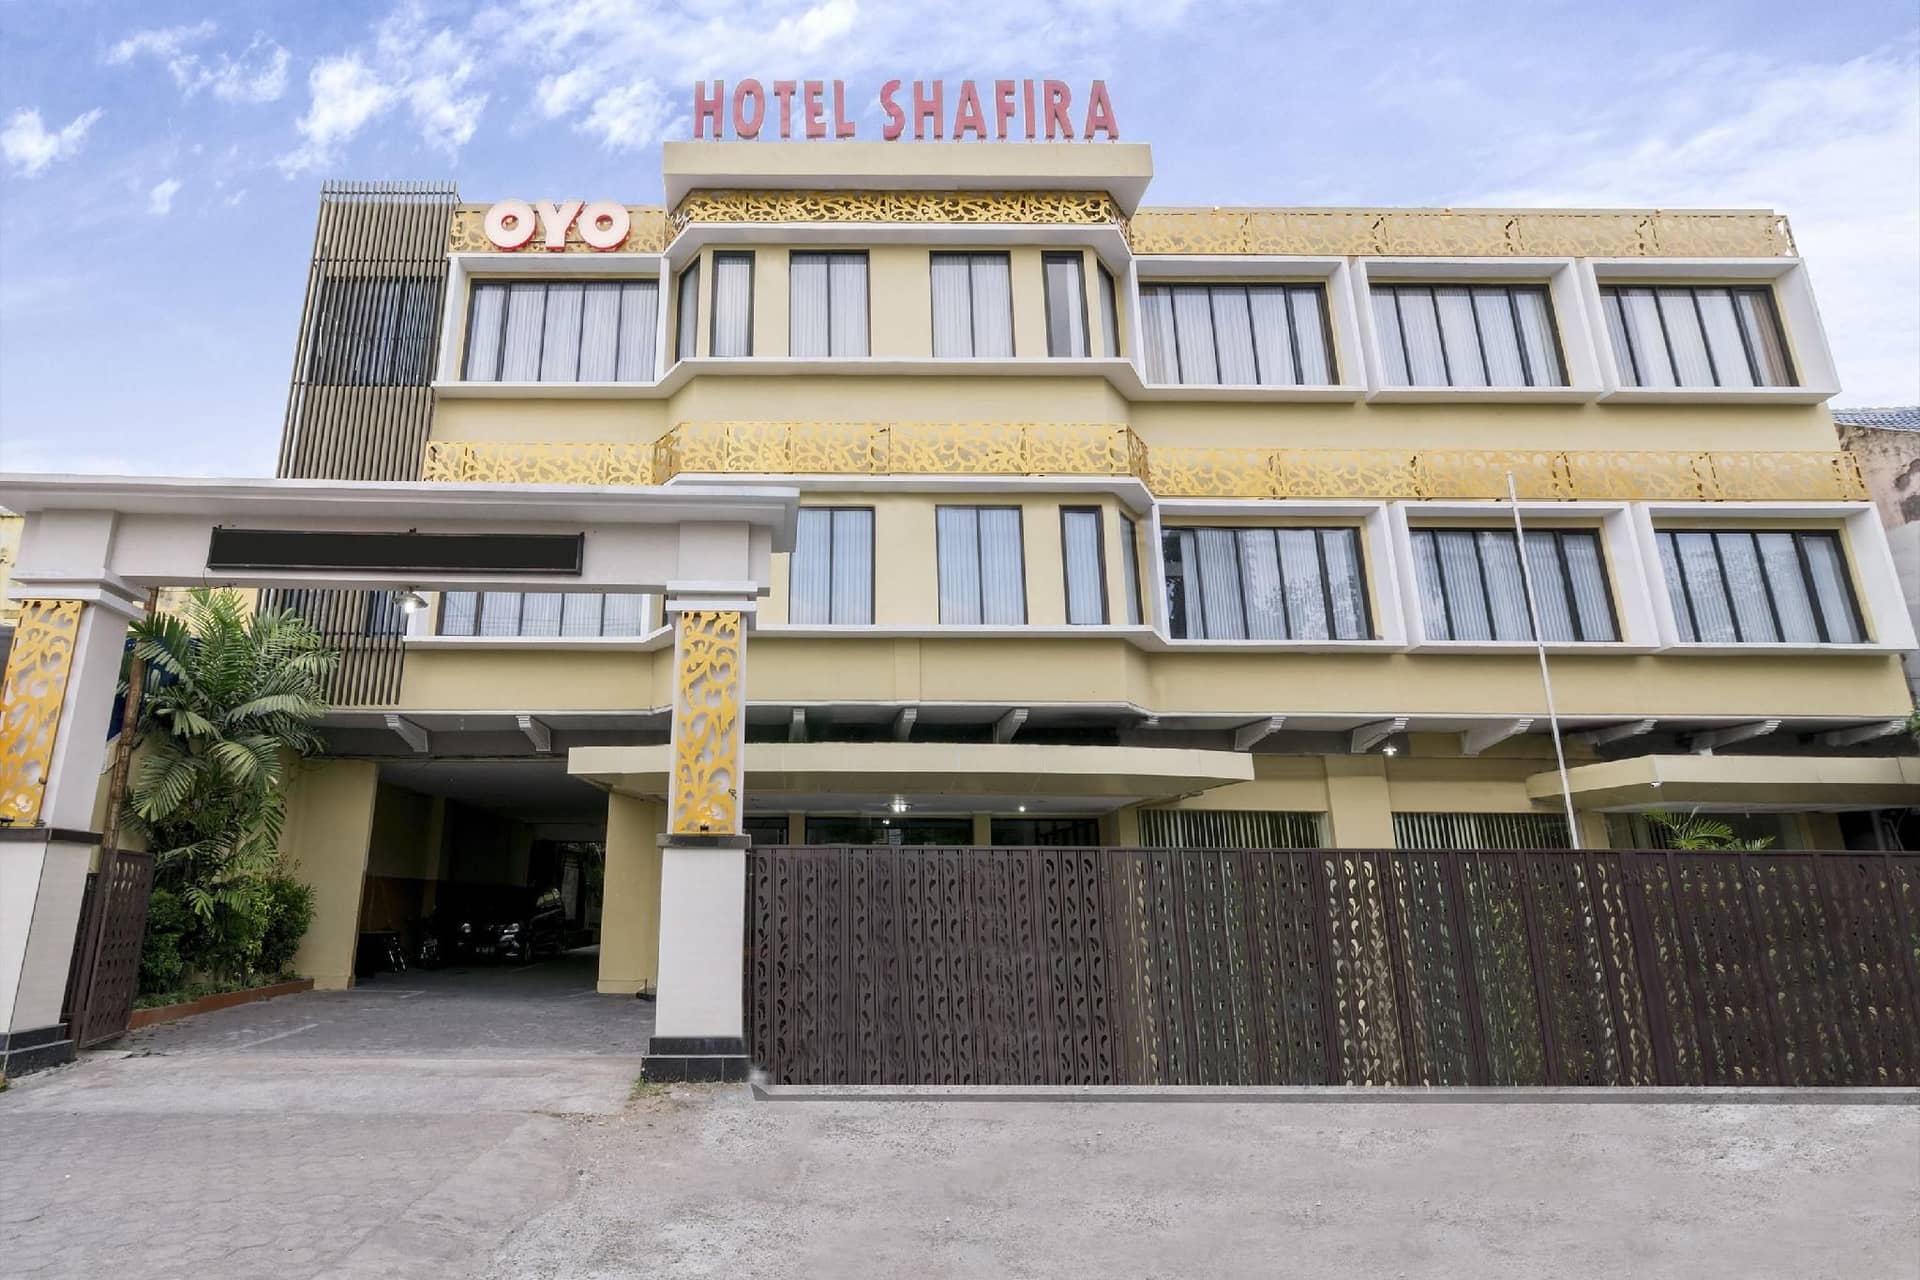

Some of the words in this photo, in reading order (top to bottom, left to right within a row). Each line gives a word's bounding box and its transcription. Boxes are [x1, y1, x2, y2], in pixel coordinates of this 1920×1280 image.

[694, 79, 856, 140] HOTEL
[880, 79, 1119, 141] SHAFIRA
[484, 200, 631, 251] OYO
